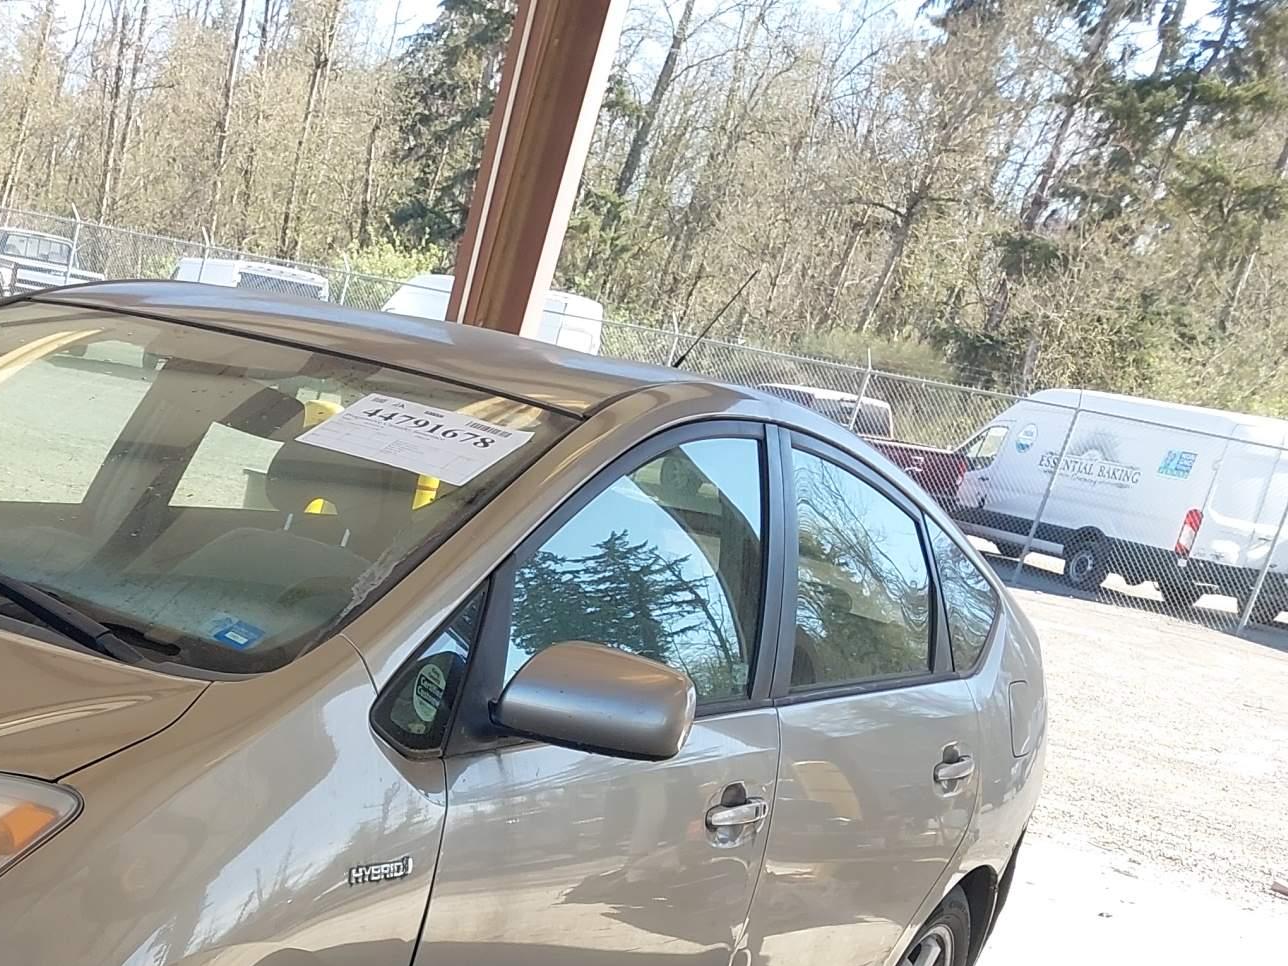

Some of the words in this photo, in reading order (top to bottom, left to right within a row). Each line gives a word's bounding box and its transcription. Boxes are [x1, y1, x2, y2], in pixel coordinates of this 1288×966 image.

[363, 408, 496, 449] 44791678
[1038, 455, 1094, 476] ESSNTIAL
[1097, 465, 1142, 484] BAKING
[350, 860, 405, 884] HYBRID
